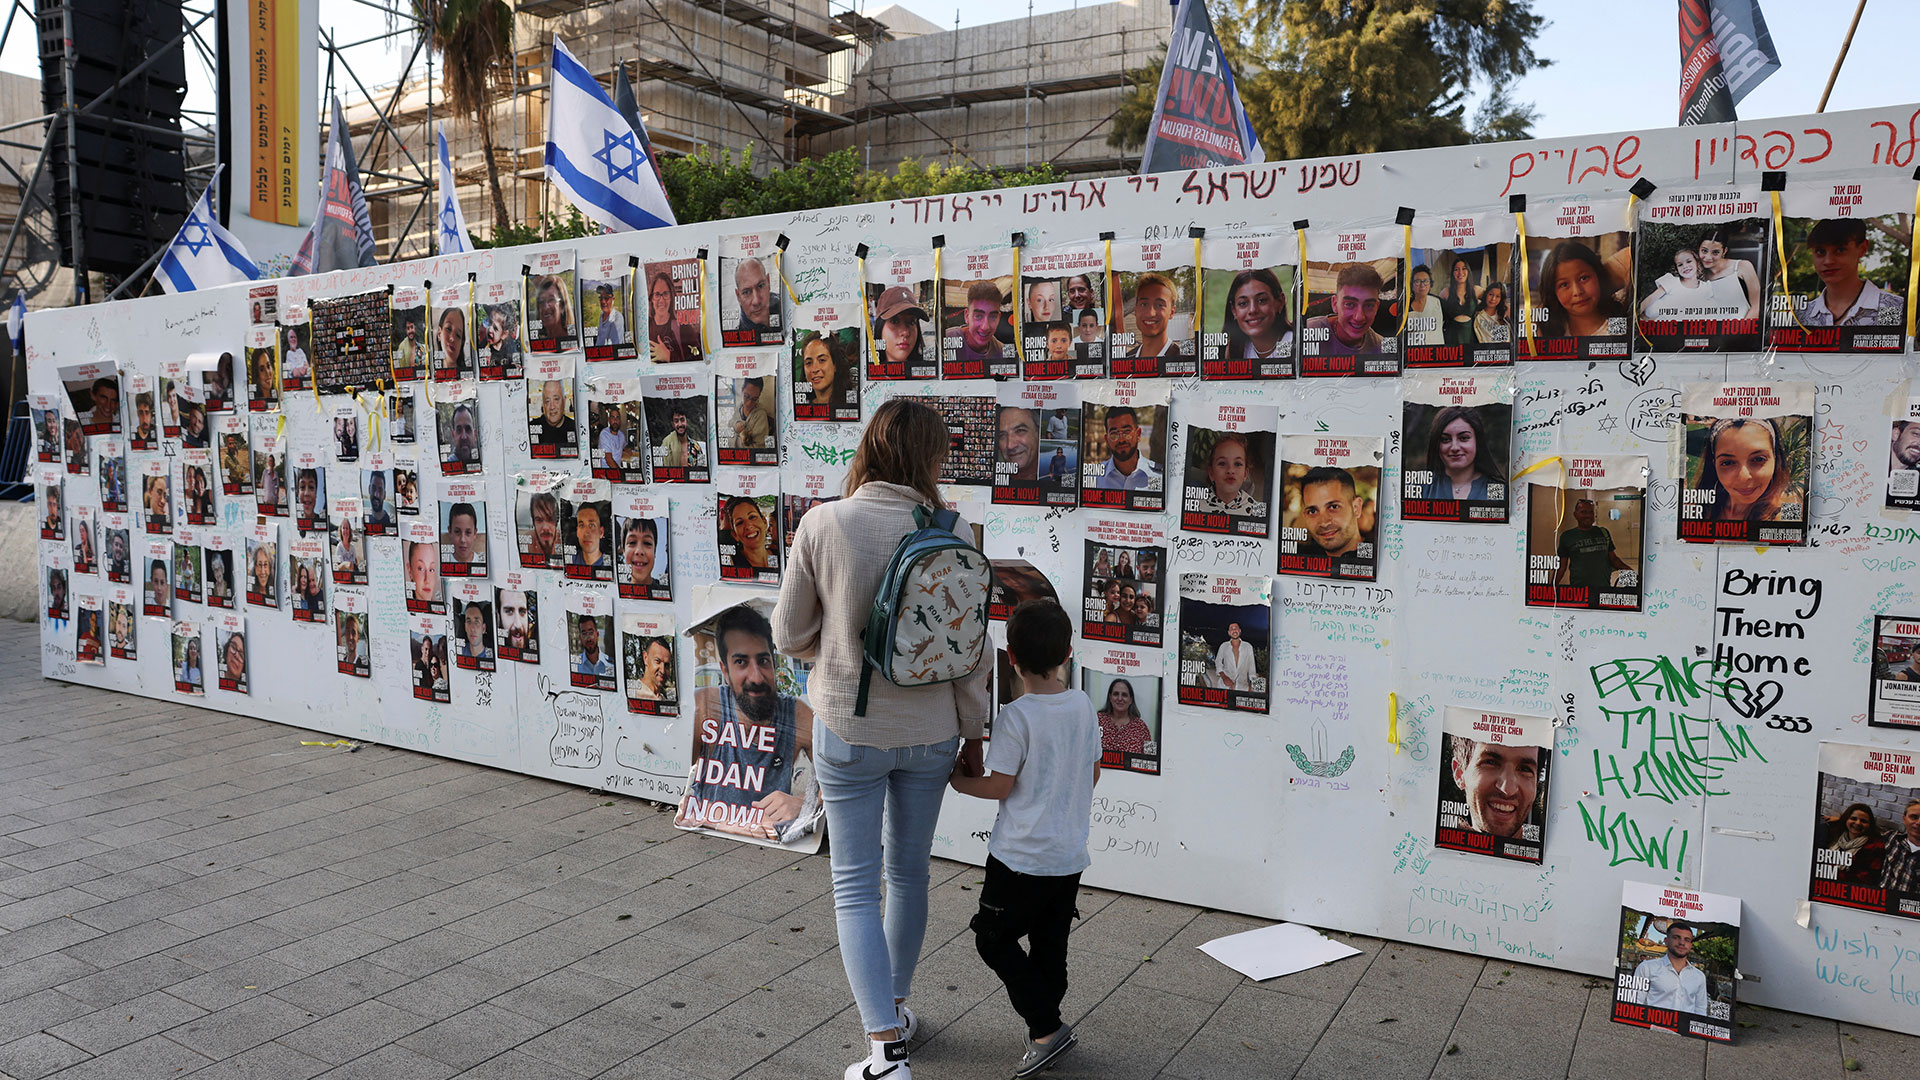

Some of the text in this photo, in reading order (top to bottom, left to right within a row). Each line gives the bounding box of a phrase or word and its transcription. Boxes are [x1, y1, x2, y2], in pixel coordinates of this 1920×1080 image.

[256, 48, 268, 84] ללמוד
[256, 103, 268, 148] להיפגש
[282, 136, 291, 164] ימים
[1695, 128, 1833, 181] כפדיון
[1499, 135, 1643, 198] שבויים
[256, 166, 268, 203] לבלות
[1297, 159, 1362, 194] שמע
[282, 167, 292, 208] בשבוע
[1022, 179, 1107, 214] אלהינו
[1829, 195, 1863, 206] NOAM OR
[1651, 202, 1758, 218] דפנה (15) ואלה (8) אליקים
[1838, 206, 1852, 217] (17)
[1225, 221, 1247, 231] TOP
[1556, 215, 1596, 226] YUVAL ANGEL
[1442, 227, 1475, 238] MIKA ANGEL
[1337, 242, 1366, 252] OFIR ENGEL
[1453, 237, 1464, 247] (18)
[1236, 250, 1259, 259] ALMA OR
[672, 262, 698, 280] BRING
[682, 278, 700, 294] NILI
[674, 294, 700, 311] HOME
[1408, 317, 1436, 332] BRING
[1639, 318, 1760, 336] BRING THEM HOME
[1770, 311, 1793, 327] HIM
[1303, 327, 1330, 342] BRING
[1407, 332, 1426, 346] HER
[1769, 327, 1841, 346] HOME NOW!
[1203, 346, 1219, 360] HER
[1303, 341, 1320, 356] HIM
[1407, 344, 1464, 362] HOME NOW!
[1548, 337, 1578, 354] NOW!
[1025, 349, 1045, 362] THEM
[1302, 355, 1355, 371] HOME NOW!
[1114, 389, 1137, 397] RAN GVILI
[1439, 386, 1477, 395] KARINA ARIEV
[1451, 396, 1463, 405] (19)
[1713, 397, 1780, 406] MORAN STELA YANAI
[1218, 413, 1246, 423] ELA ELYAKIM
[1738, 406, 1753, 417] (40)
[1314, 448, 1350, 457] URIEL BARUCH
[1326, 457, 1337, 465] (35)
[1405, 470, 1433, 485] BRING
[1569, 468, 1605, 478] ITZIK DAHAN
[1579, 478, 1593, 487] (48)
[994, 487, 1040, 500] HOME NOW!
[1405, 484, 1423, 499] HER
[1683, 488, 1716, 505] BRING
[1185, 499, 1200, 512] HER
[1404, 500, 1460, 515] HOME NOW!
[1682, 504, 1703, 520] HER
[1681, 521, 1748, 538] HOME NOW!
[1281, 556, 1332, 572] HOME NOW!
[1530, 555, 1560, 570] BRING
[930, 565, 953, 582] ROAR
[1530, 569, 1549, 584] HIM
[958, 578, 972, 599] ROAR
[1212, 585, 1241, 595] ELIYA COHEN
[1296, 581, 1356, 602] חזקים!
[1560, 585, 1589, 602] NOW!
[1722, 568, 1822, 619] Bring
[926, 604, 943, 625] ROAR
[1716, 607, 1805, 640] Them
[922, 652, 944, 667] ROAR
[1714, 643, 1812, 676] Home
[1181, 672, 1197, 686] HIM
[1589, 655, 1746, 707] BRING
[1885, 682, 1917, 692] JONATHAN
[1473, 721, 1523, 736] SAGUI DEKEL CHEN
[1765, 714, 1813, 734] 333
[700, 718, 776, 753] SAVE
[1490, 733, 1503, 743] (35)
[1598, 705, 1768, 764] THEM
[695, 757, 766, 793] IDAN
[1593, 748, 1731, 804] HOME
[1863, 760, 1915, 776] OHAD BEN AMI
[1880, 773, 1896, 784] (55)
[684, 795, 765, 830] NOW!
[1441, 800, 1470, 816] BRING
[1440, 814, 1458, 829] HIM
[1439, 828, 1495, 850] HOME NOW!
[1577, 800, 1689, 882] NOW!
[1816, 848, 1853, 867] BRING
[1815, 863, 1839, 881] HIM
[1814, 880, 1887, 906] HOME NOW!
[1658, 897, 1704, 912] TOMER AHIMAS
[1673, 909, 1687, 918] (20)
[1815, 926, 1878, 960] Wish
[1618, 973, 1650, 992] BRING
[1816, 957, 1878, 994] Were
[1616, 988, 1637, 1004] HIM
[1615, 1003, 1679, 1027] HOME NOW!
[892, 1046, 905, 1056] NIKE
